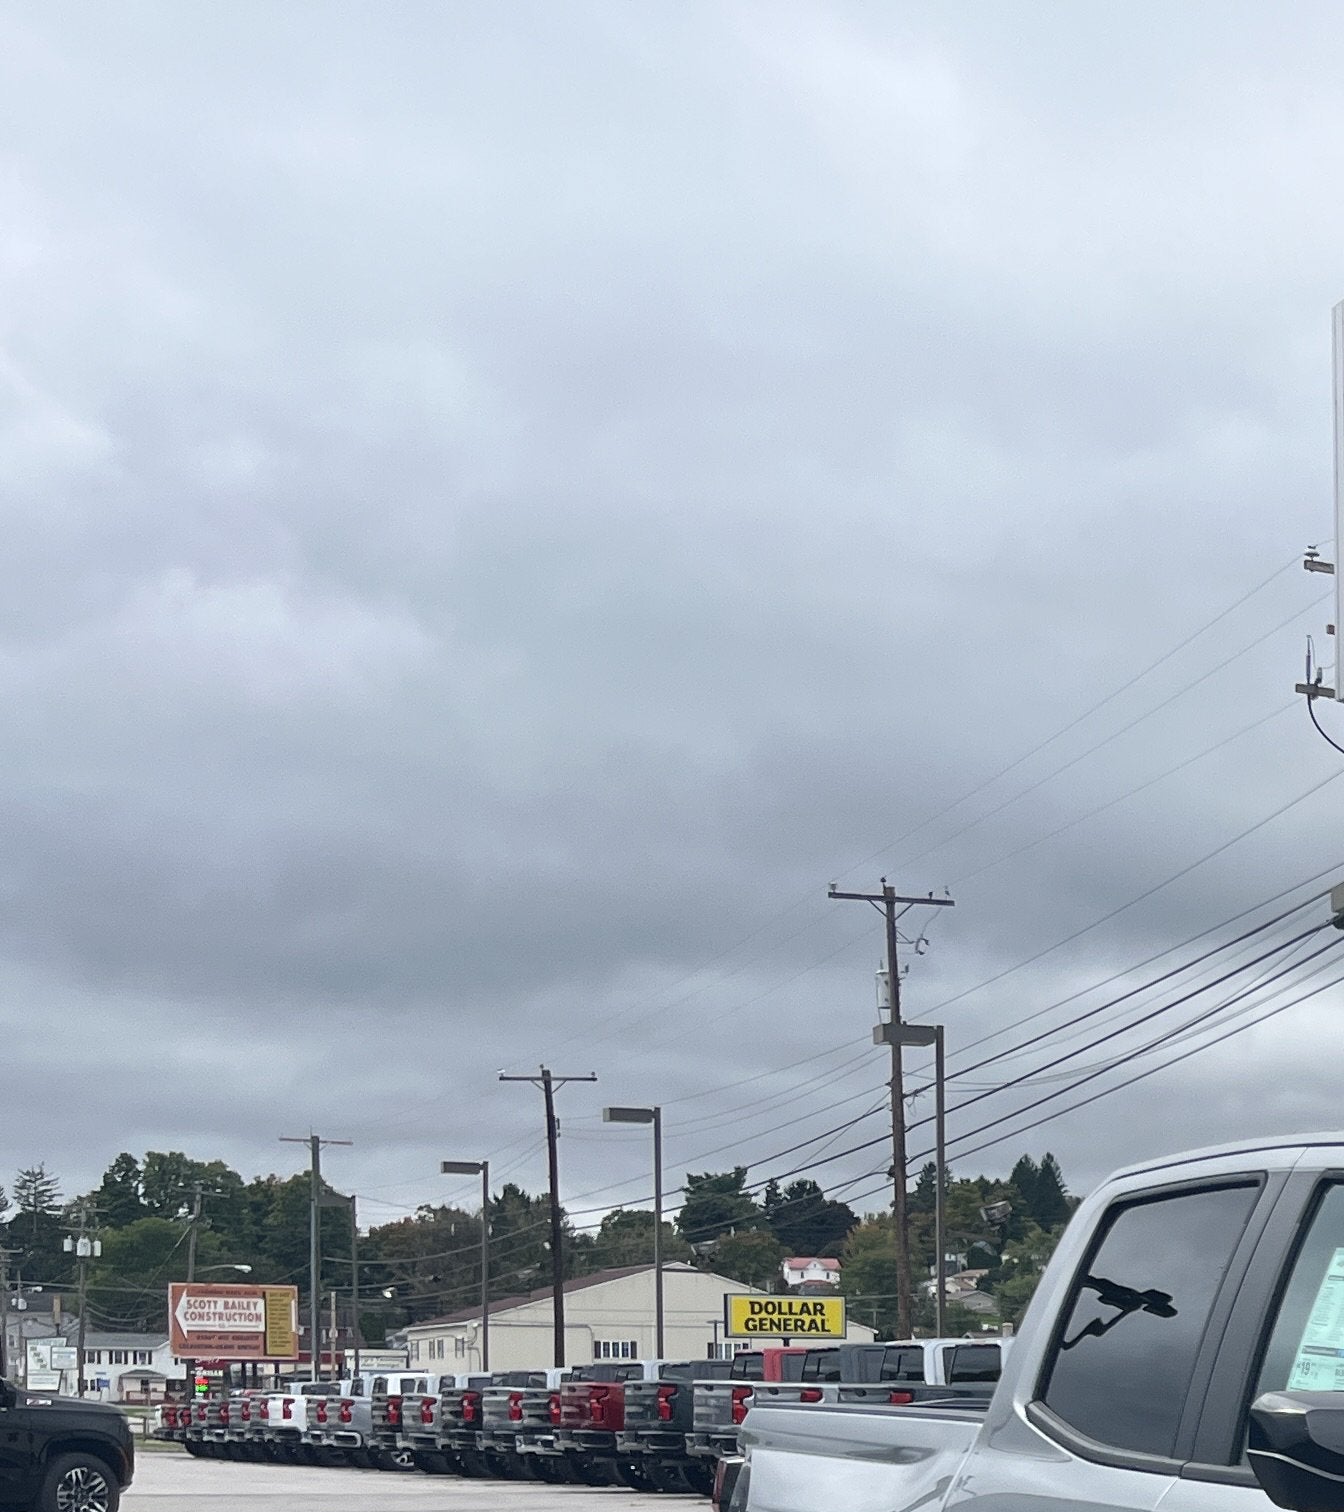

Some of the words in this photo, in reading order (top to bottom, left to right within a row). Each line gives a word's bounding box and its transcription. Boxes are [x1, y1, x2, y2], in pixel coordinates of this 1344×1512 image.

[186, 1299, 219, 1311] SCOTT
[222, 1300, 259, 1312] BAILEY
[748, 1300, 826, 1317] DOLLAR
[183, 1311, 262, 1323] CONSTRUCTION
[743, 1317, 832, 1333] GENERAL
